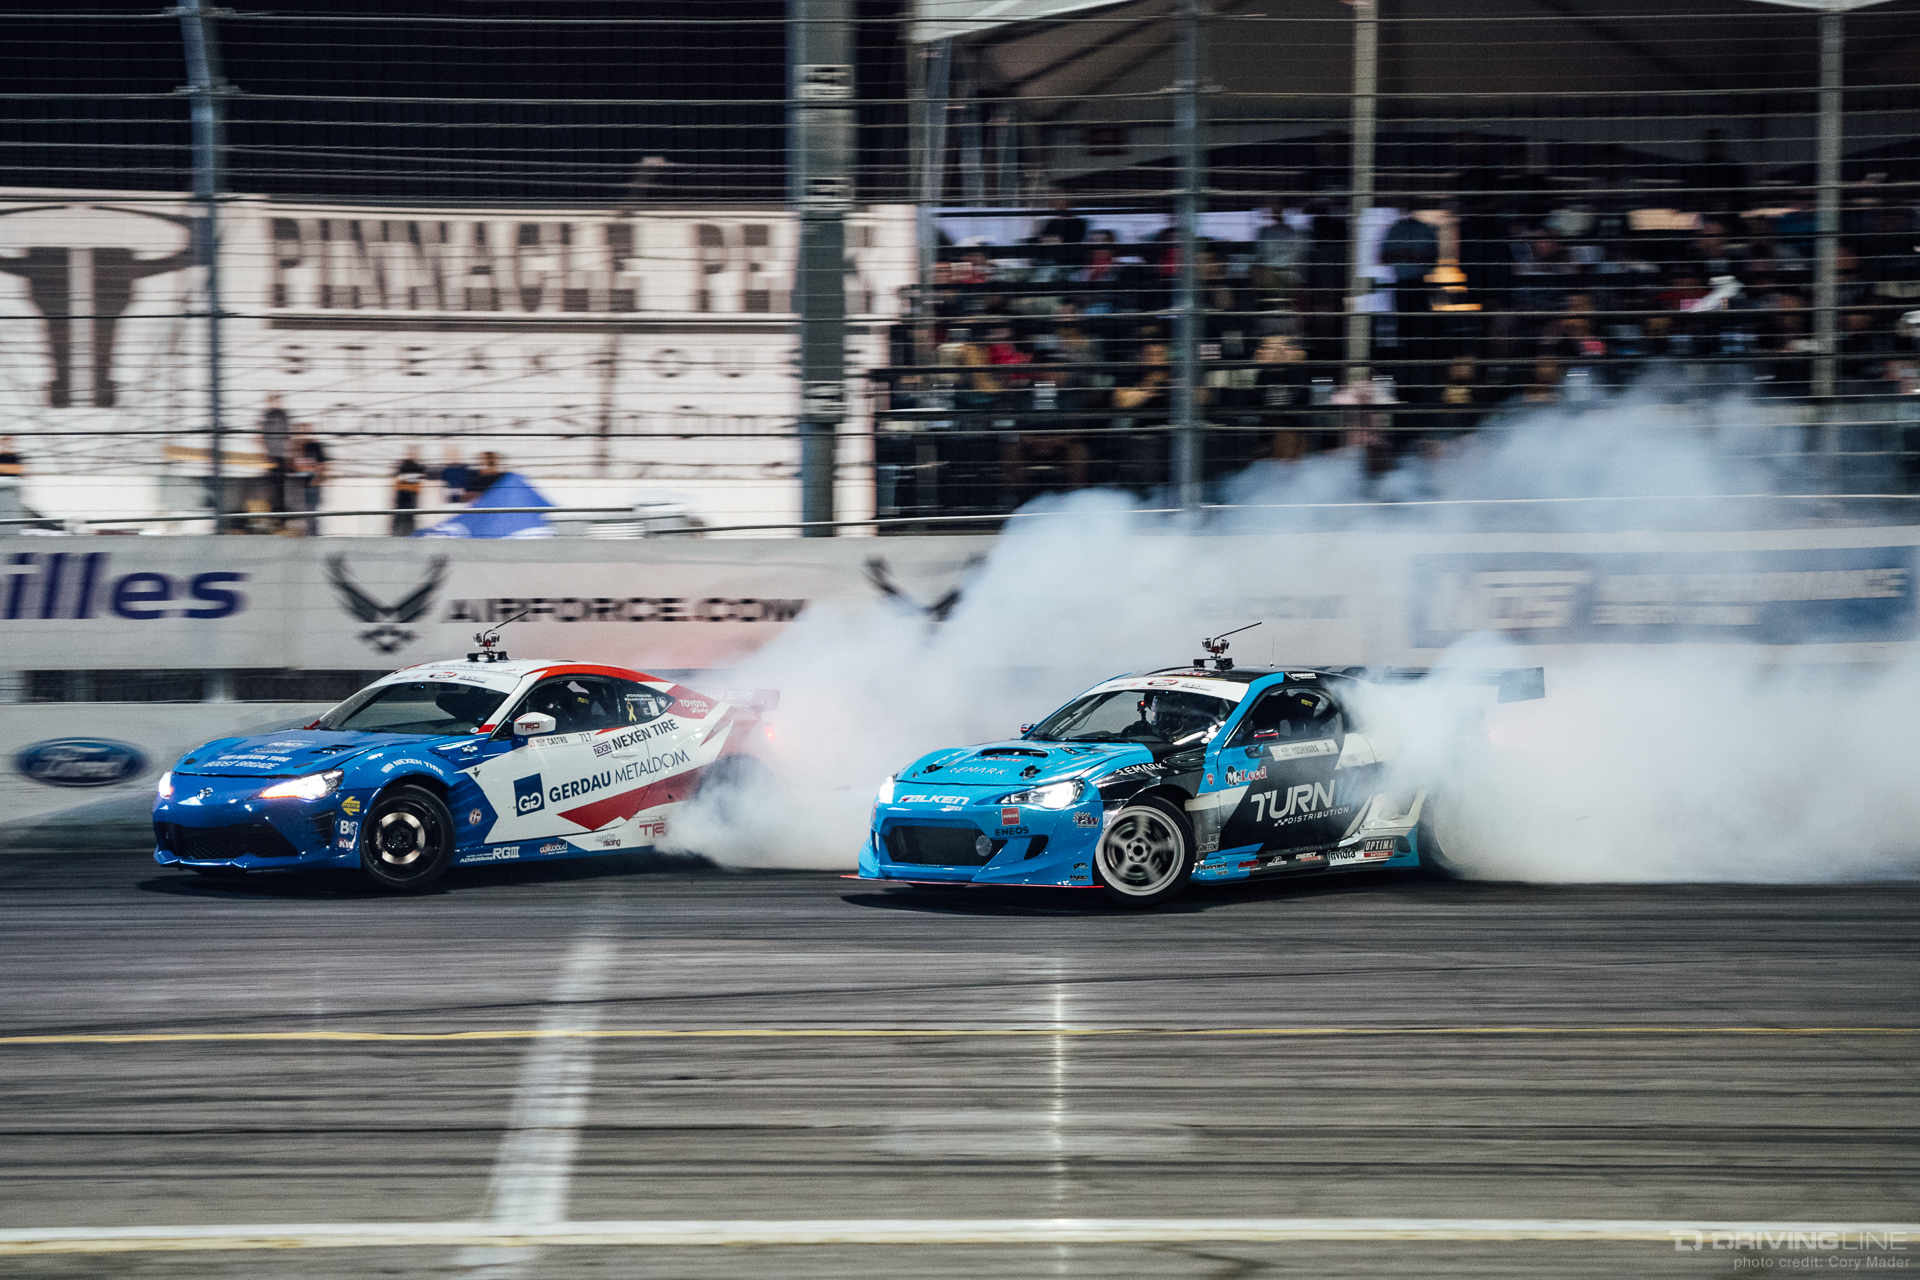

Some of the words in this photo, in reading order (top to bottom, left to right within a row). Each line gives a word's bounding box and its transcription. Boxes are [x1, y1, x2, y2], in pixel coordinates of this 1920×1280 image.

[272, 217, 638, 313] PINNACLE
[696, 222, 873, 314] PEK
[678, 699, 709, 708] TOYOTA
[518, 722, 540, 731] TRD
[612, 727, 652, 750] NEXEN
[650, 718, 680, 736] TIRE
[546, 736, 569, 746] CASTRO
[392, 758, 423, 767] NEXEN
[423, 760, 445, 777] TIRE
[549, 770, 612, 803] GERDAU
[614, 748, 691, 784] METALDOM
[897, 794, 970, 805] FALKEN
[1287, 806, 1350, 825] DISTRIBUTION
[639, 822, 667, 838] TR
[994, 825, 1030, 837] ENEOS
[1365, 838, 1394, 851] OPTIMA
[1200, 861, 1228, 871] Honeywell
